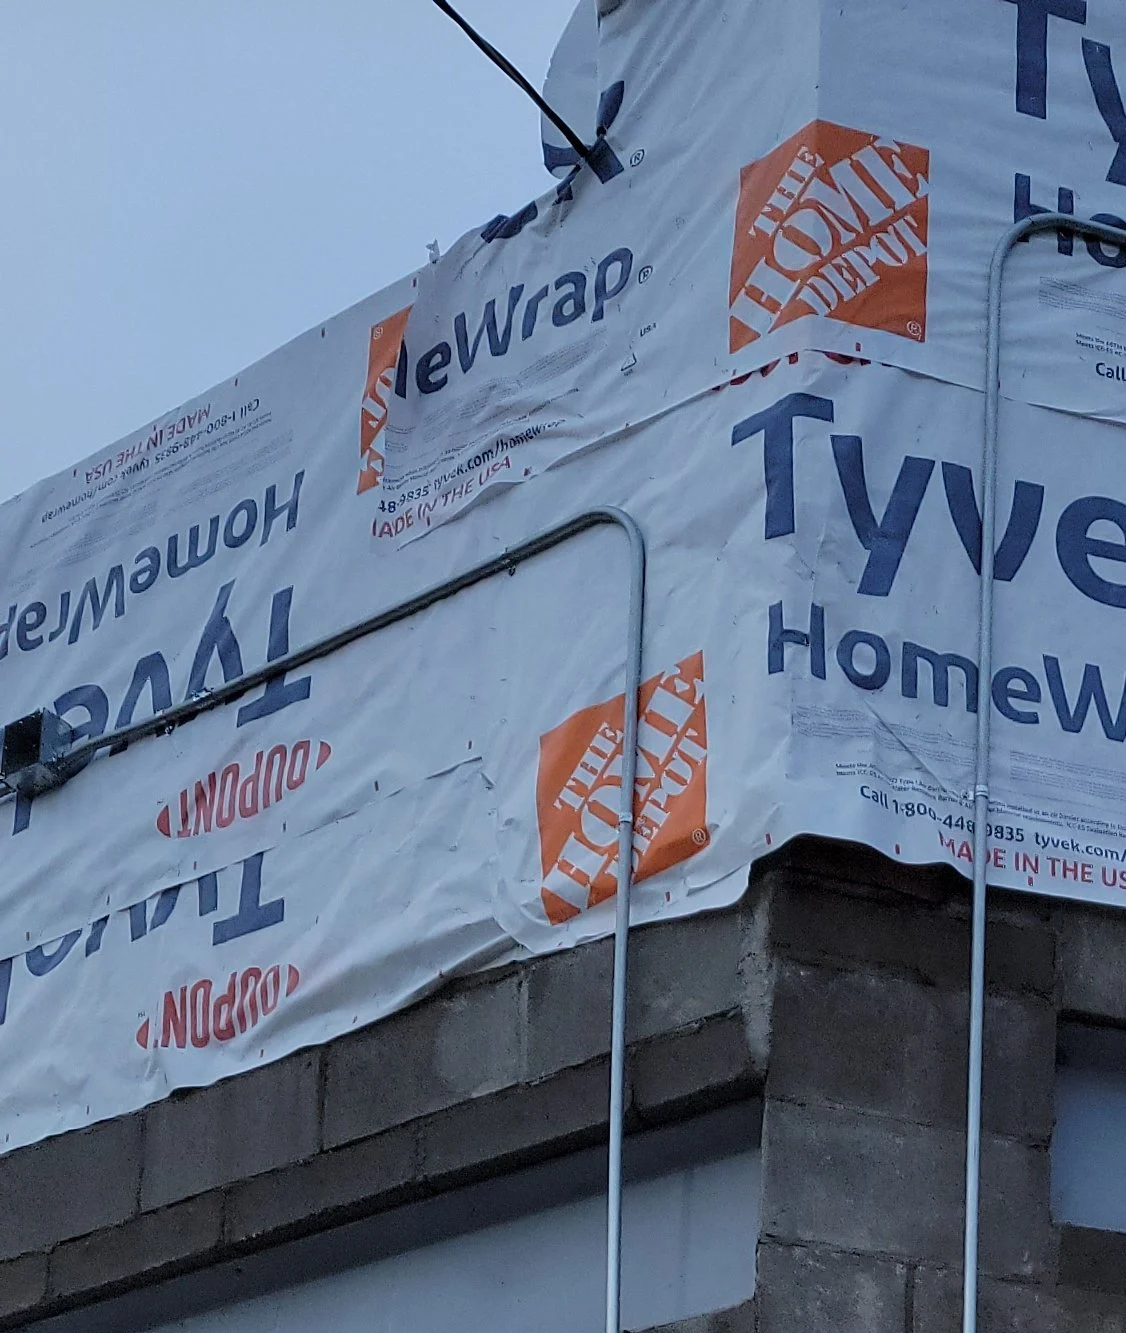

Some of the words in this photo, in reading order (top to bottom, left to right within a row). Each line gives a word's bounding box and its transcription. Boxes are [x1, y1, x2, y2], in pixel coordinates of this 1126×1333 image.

[748, 145, 823, 237] THE
[729, 138, 929, 335] HOME
[799, 215, 928, 316] DEPOT
[1095, 362, 1126, 382] Call
[147, 424, 164, 453] IN
[167, 403, 211, 440] MADE
[85, 459, 112, 484] USA
[117, 444, 143, 469] THE
[442, 477, 474, 507] THE
[479, 456, 511, 486] USA
[553, 721, 623, 812] THE
[178, 739, 311, 838] DUPONT
[860, 785, 889, 810] Call
[1014, 852, 1040, 874] IN
[1046, 856, 1094, 884] THE
